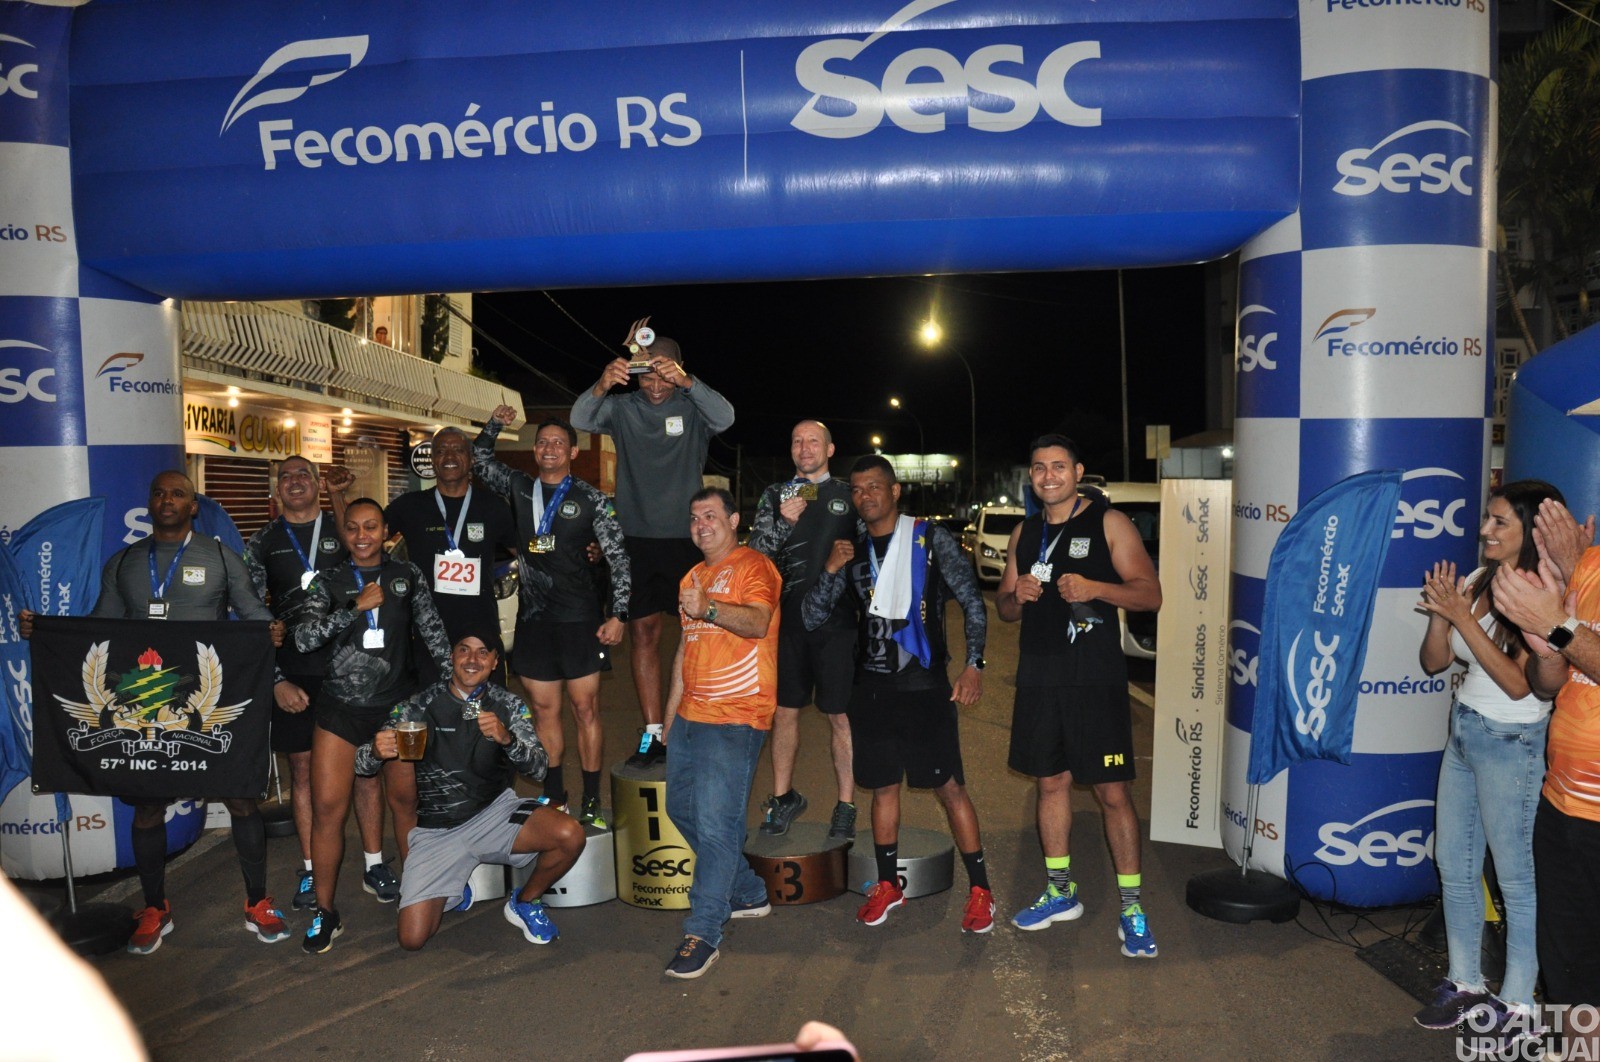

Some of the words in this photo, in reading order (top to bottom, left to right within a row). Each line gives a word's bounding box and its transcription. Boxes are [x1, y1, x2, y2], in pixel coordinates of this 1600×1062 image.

[259, 101, 598, 170] Fecomércio
[616, 92, 702, 149] RS
[35, 224, 67, 242] RS
[1327, 336, 1458, 357] Fecomércio
[1463, 338, 1482, 356] RS
[1234, 500, 1261, 520] ércio
[1265, 504, 1290, 523] RS
[437, 561, 475, 584] 223
[1313, 515, 1339, 614] Fecomércio
[1331, 563, 1351, 616] Senac
[1192, 623, 1206, 699] Sindicatos
[1215, 668, 1224, 705] Sistema
[1359, 676, 1445, 694] omércio
[90, 730, 125, 746] FORÇA
[171, 731, 213, 747] NACIONAL
[1190, 722, 1203, 741] RS
[139, 742, 163, 750] MJ
[129, 759, 157, 770] INC
[171, 760, 208, 771] 2014
[1103, 753, 1125, 768] FN
[1186, 746, 1202, 829] Fecomércio
[2, 819, 62, 836] mércio
[76, 814, 107, 832] RS
[1223, 802, 1247, 829] ércio
[1254, 817, 1279, 841] RS
[632, 882, 691, 895] Fecomércio
[774, 861, 804, 901] 3
